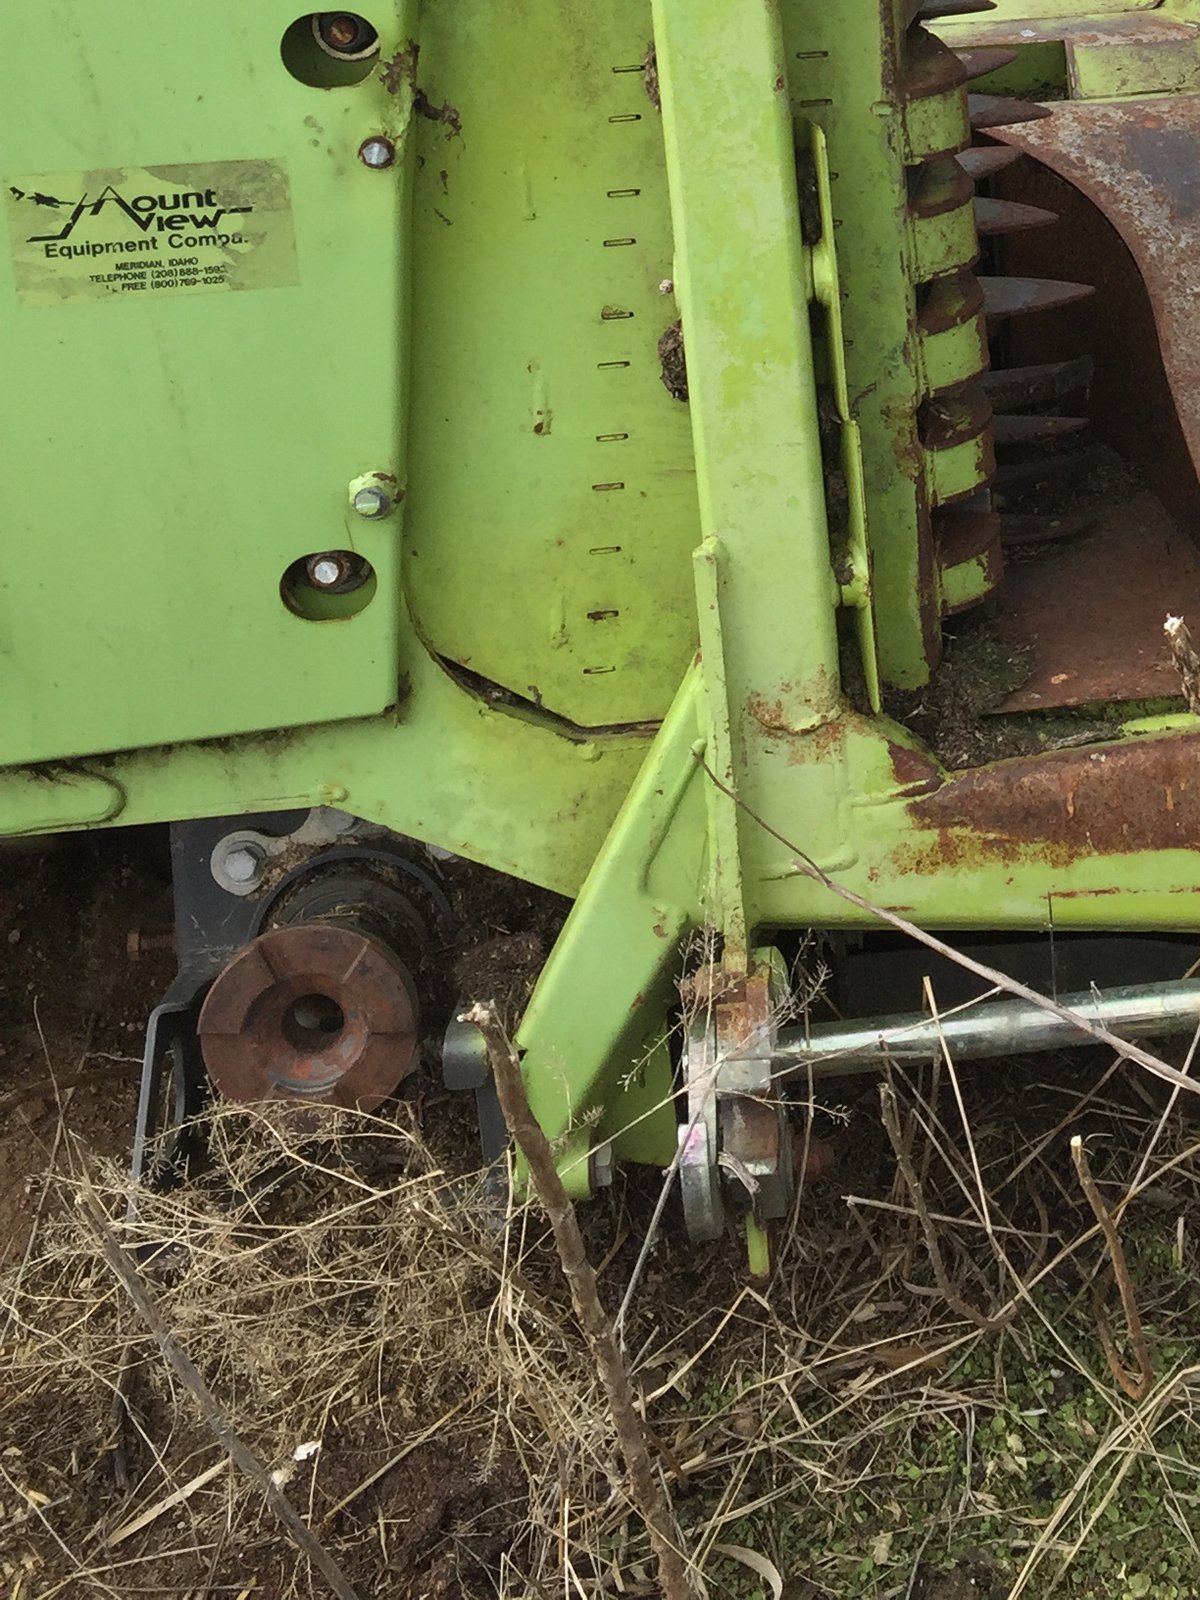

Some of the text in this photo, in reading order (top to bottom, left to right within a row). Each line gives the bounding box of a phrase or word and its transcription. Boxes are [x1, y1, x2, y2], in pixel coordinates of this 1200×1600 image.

[44, 236, 158, 259] Equipment
[168, 257, 199, 267] IDAHO
[89, 271, 147, 283] TELEPHONE
[121, 281, 147, 291] FREE
